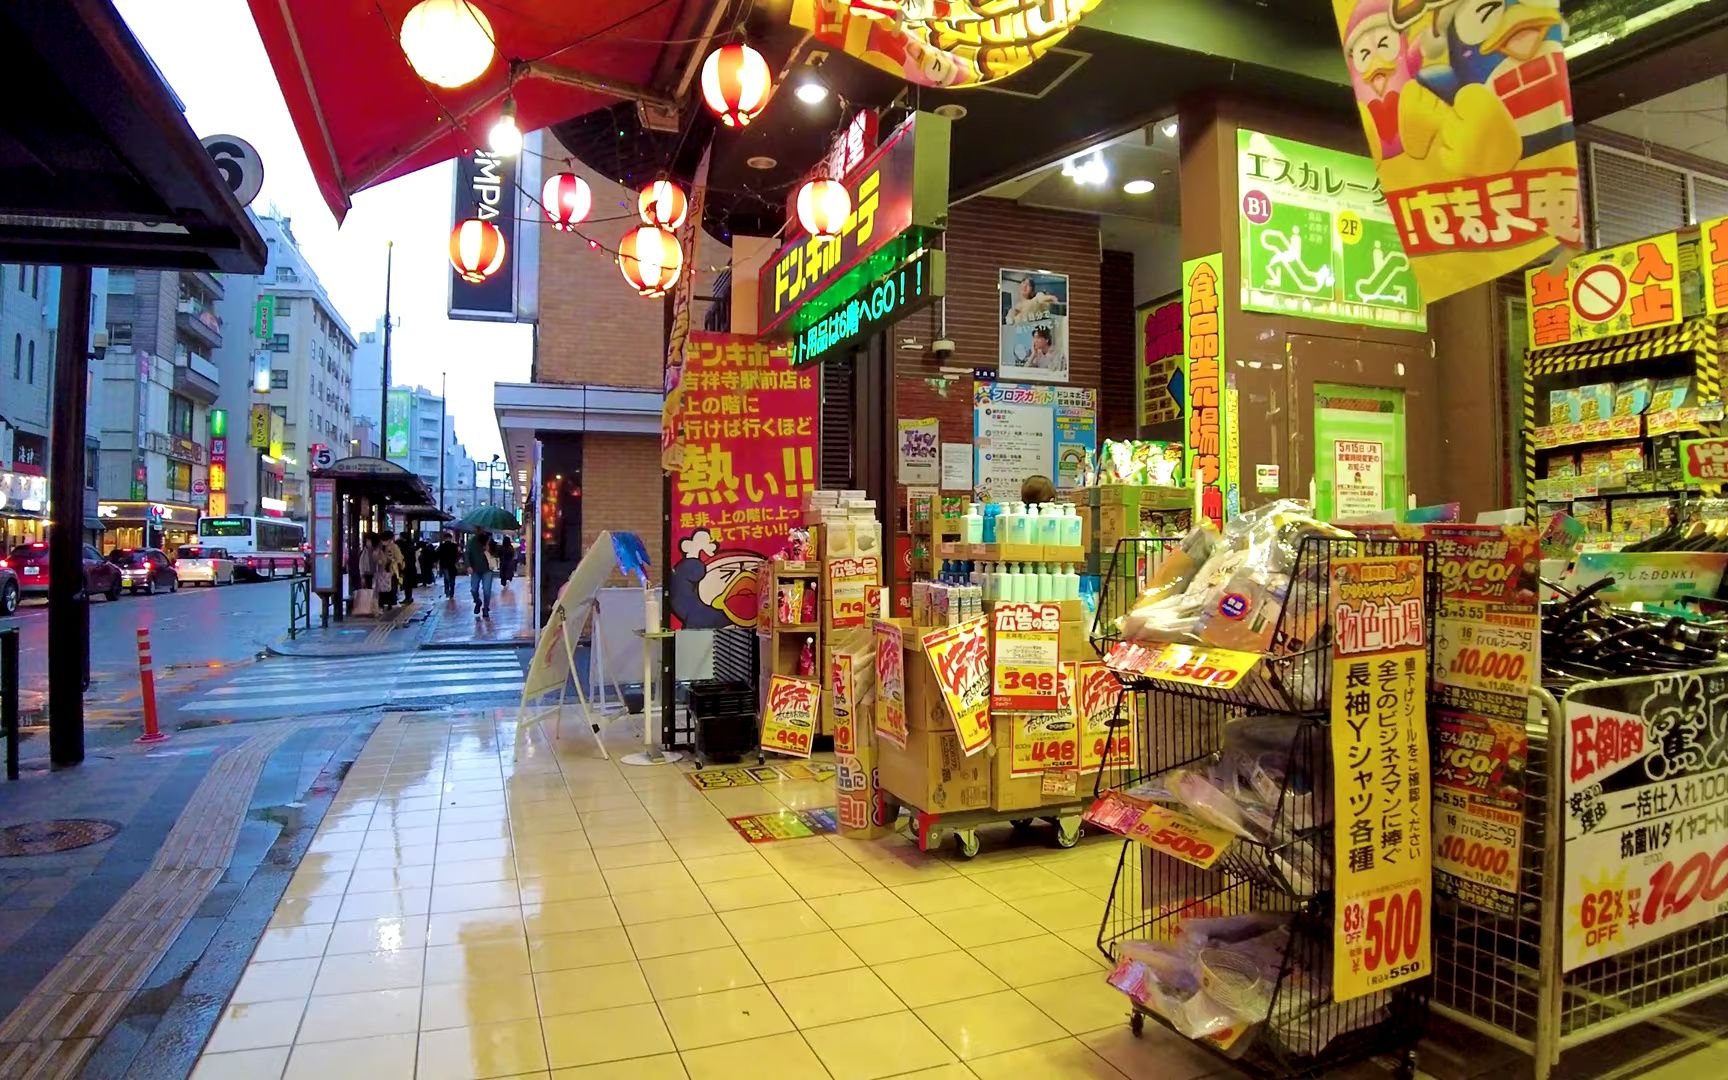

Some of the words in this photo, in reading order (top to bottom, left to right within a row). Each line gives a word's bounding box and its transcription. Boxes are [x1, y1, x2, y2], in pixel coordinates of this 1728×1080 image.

[1248, 197, 1269, 217] B1
[1341, 219, 1358, 236] 2F
[683, 395, 760, 415] 上の階に
[684, 416, 813, 440] 行けば行くほど
[318, 449, 331, 465] 5
[831, 558, 877, 578] 広告の品
[995, 607, 1060, 632] 広告の品
[1004, 671, 1054, 690] 398
[1171, 663, 1238, 683] 500
[1031, 740, 1075, 762] 498
[1570, 714, 1644, 783] 圧倒的
[1345, 662, 1374, 873] 長袖Yシャツ各種
[1376, 659, 1402, 864] 全てのビジネスマンに捧ぐ
[1621, 772, 1728, 819] 一括仕入れ100
[1580, 801, 1608, 835] 理由
[1152, 828, 1215, 860] 500
[1363, 888, 1422, 972] 500
[1585, 923, 1619, 948] OFF
